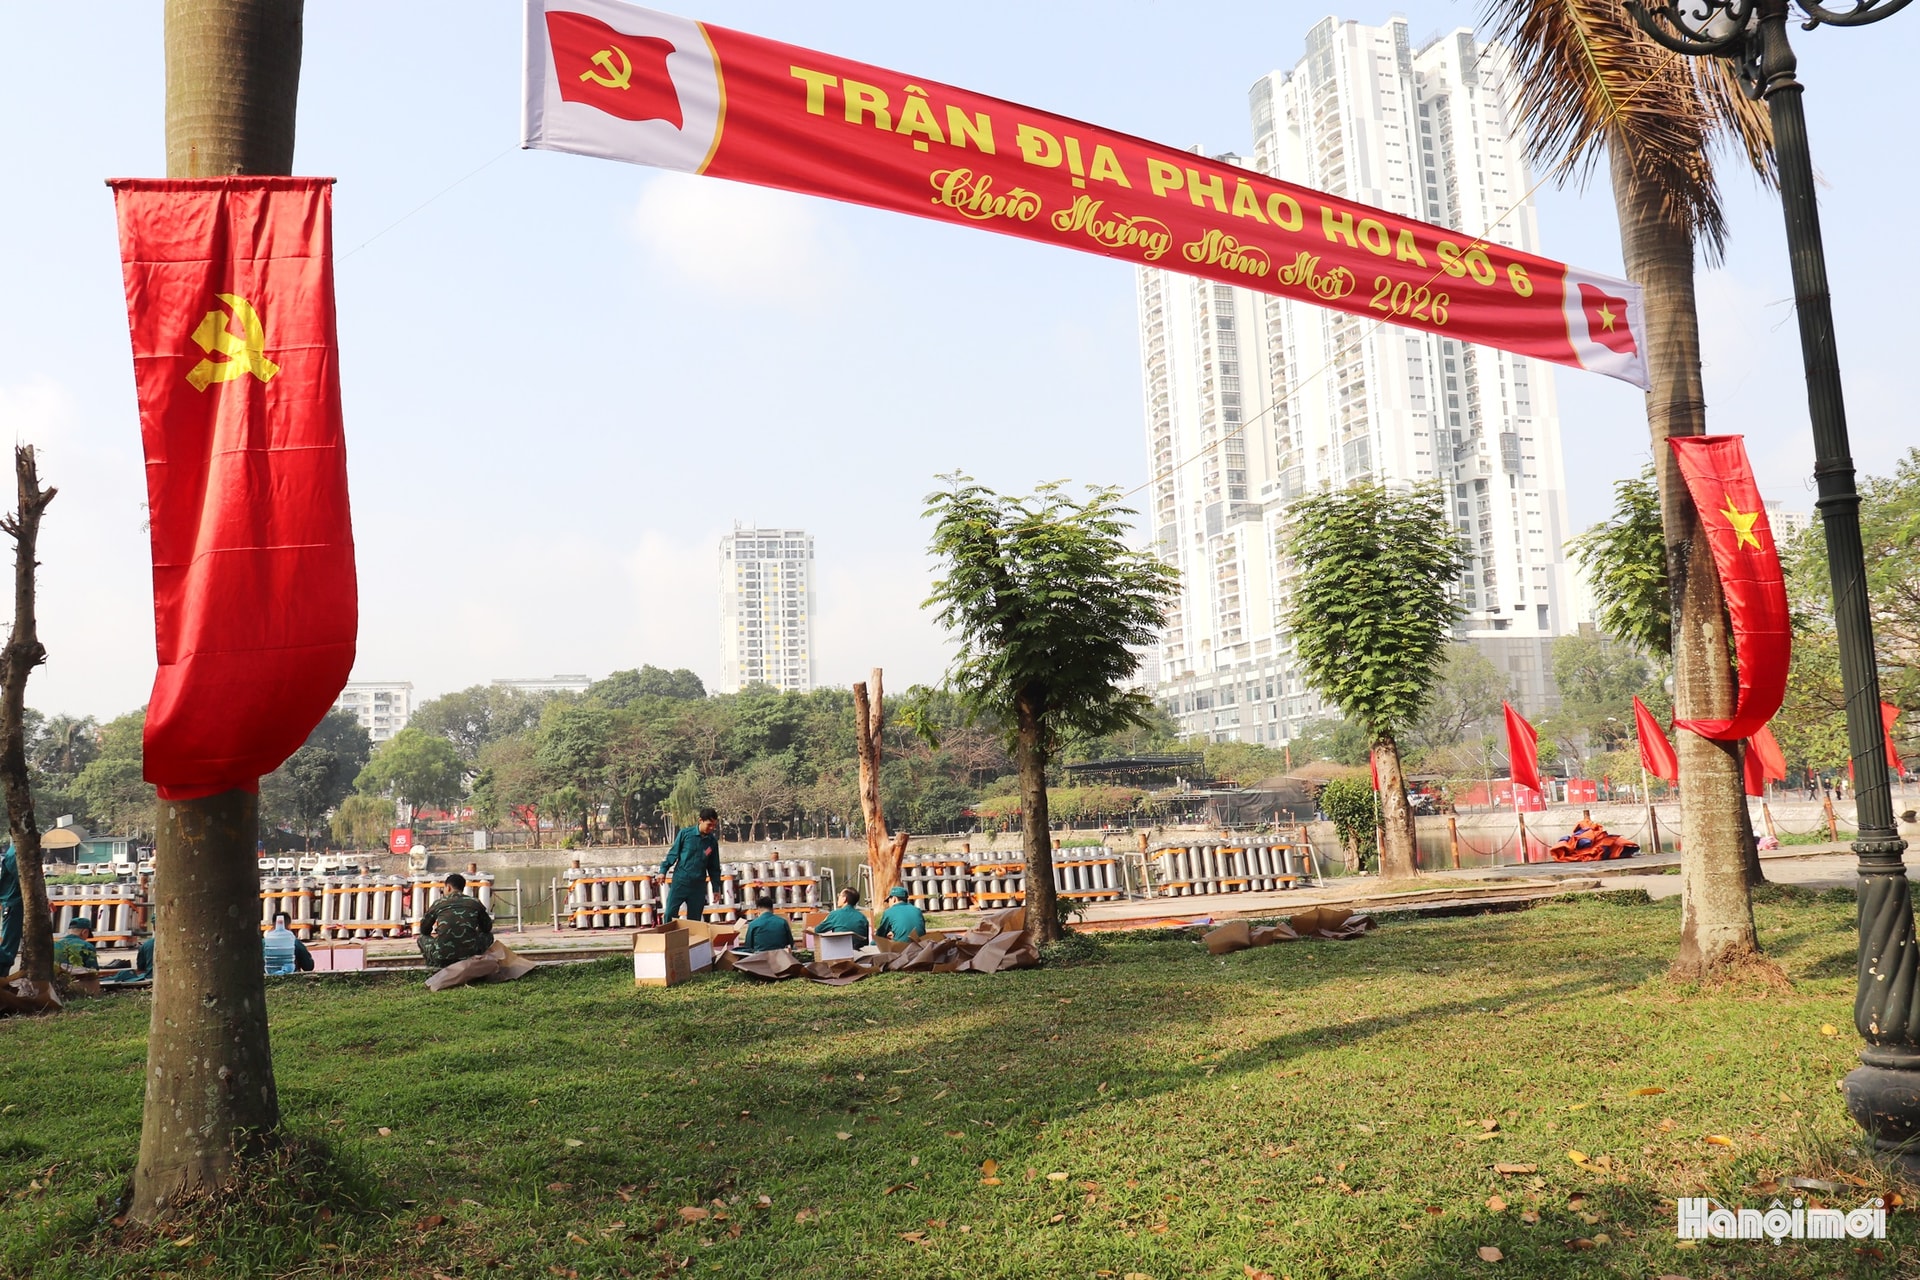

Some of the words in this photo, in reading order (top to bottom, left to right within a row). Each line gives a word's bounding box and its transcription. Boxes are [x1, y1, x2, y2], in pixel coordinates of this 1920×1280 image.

[790, 65, 996, 155] TRẬN
[1016, 123, 1132, 189] ĐỊA
[1146, 157, 1304, 232] PHÁO
[1321, 205, 1427, 268] HOA
[1436, 240, 1497, 286] SỐ
[1506, 263, 1533, 298] 6
[929, 168, 1042, 222] Chúc
[1051, 195, 1173, 261] Mừng
[1278, 251, 1356, 300] Mới
[1368, 275, 1450, 326] 2026
